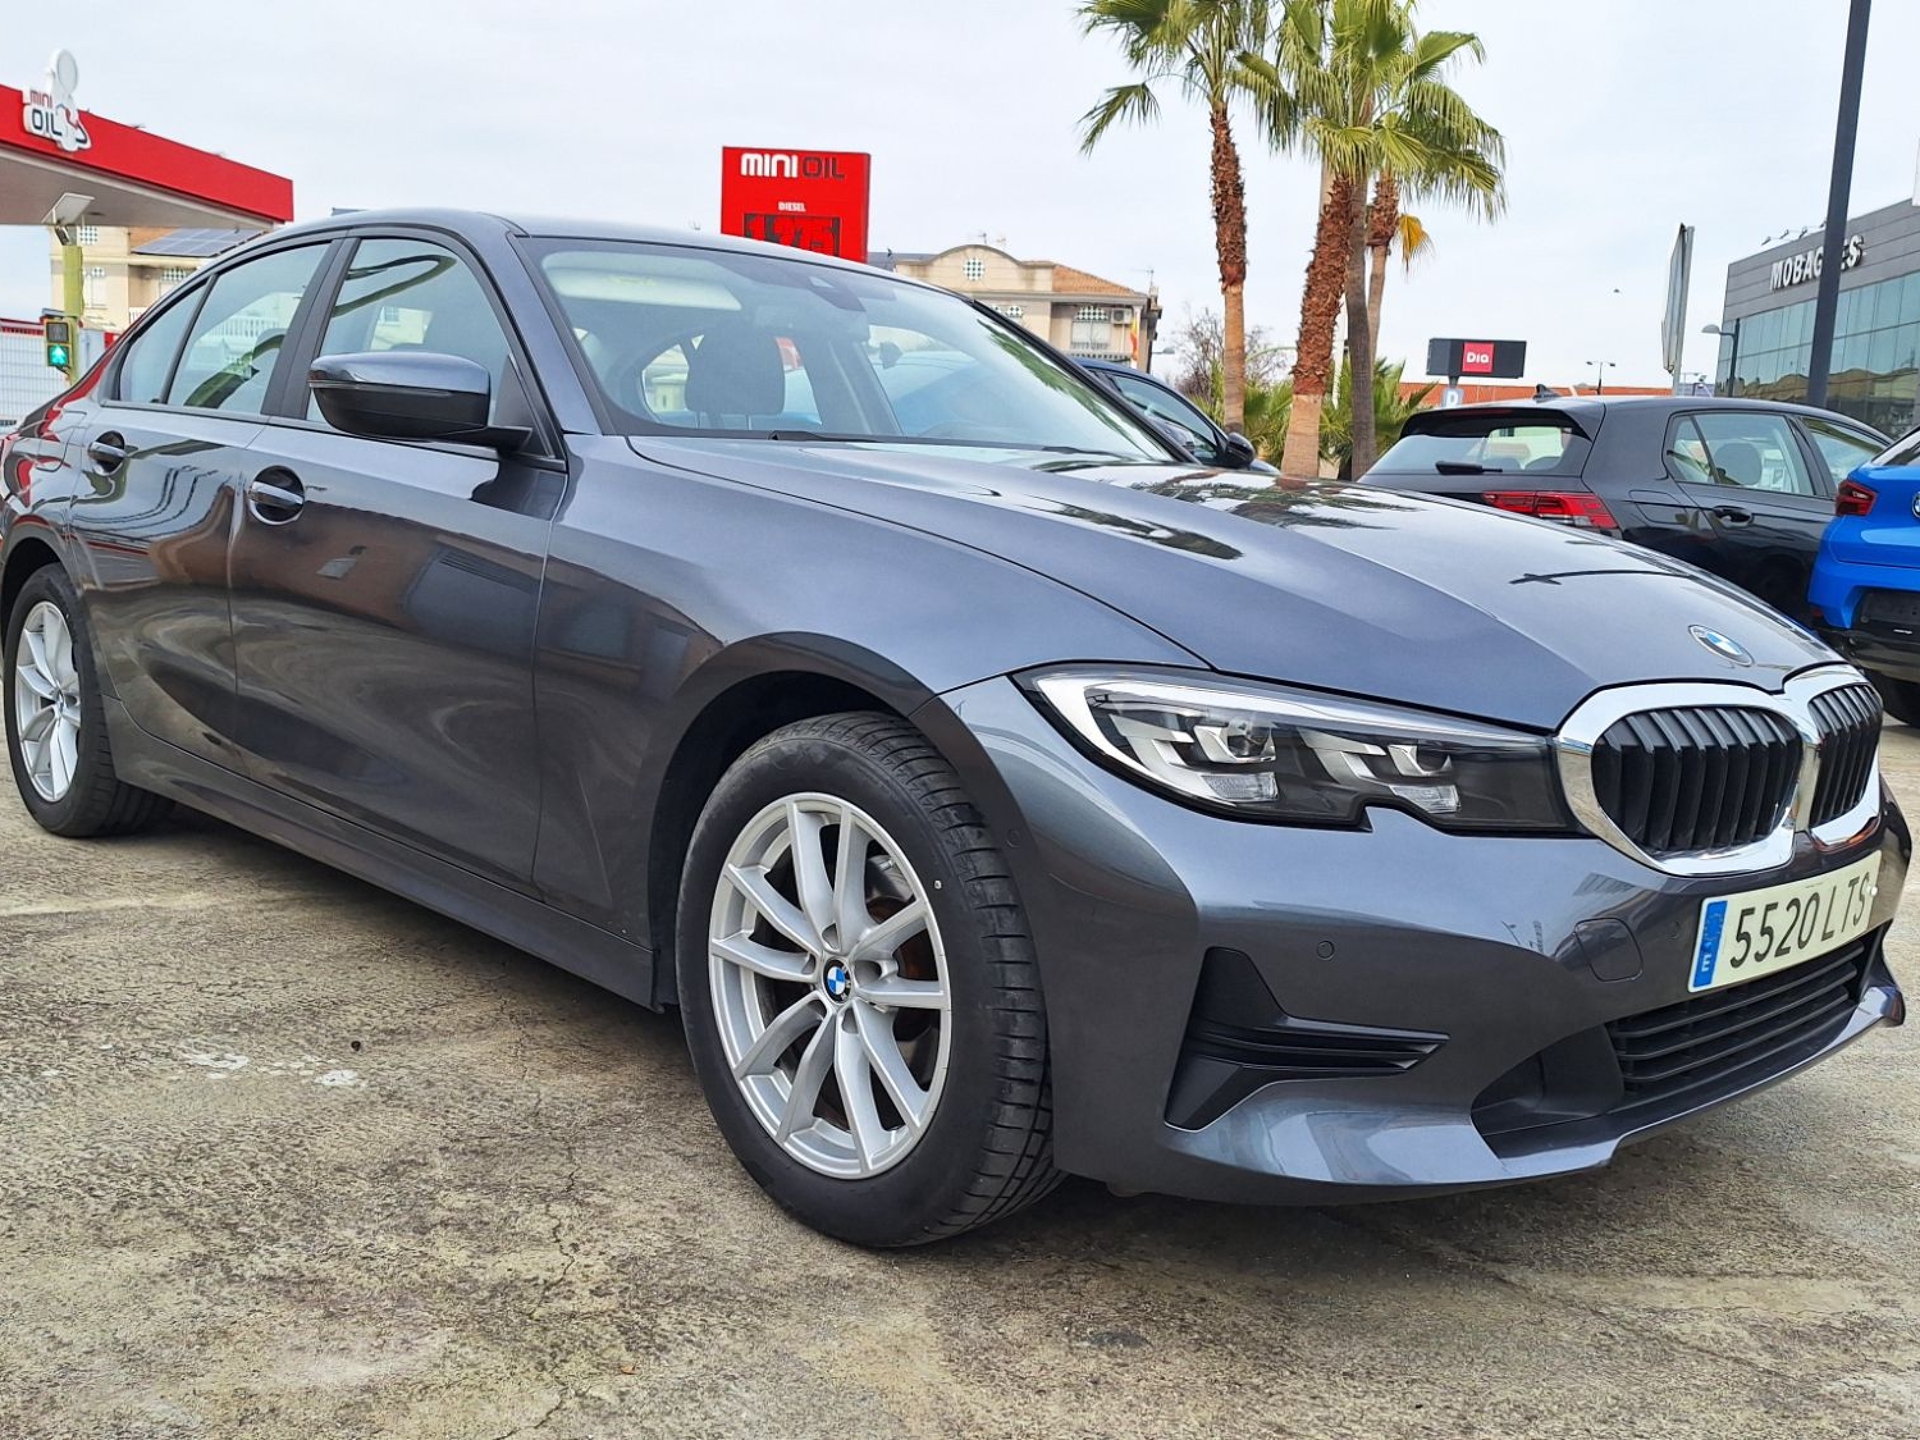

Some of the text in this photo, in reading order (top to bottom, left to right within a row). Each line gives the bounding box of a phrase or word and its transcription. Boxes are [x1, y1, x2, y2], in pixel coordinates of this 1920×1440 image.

[32, 108, 63, 136] OIL
[802, 156, 845, 179] OIL
[777, 201, 806, 212] DIESEL
[1701, 953, 1711, 972] E
